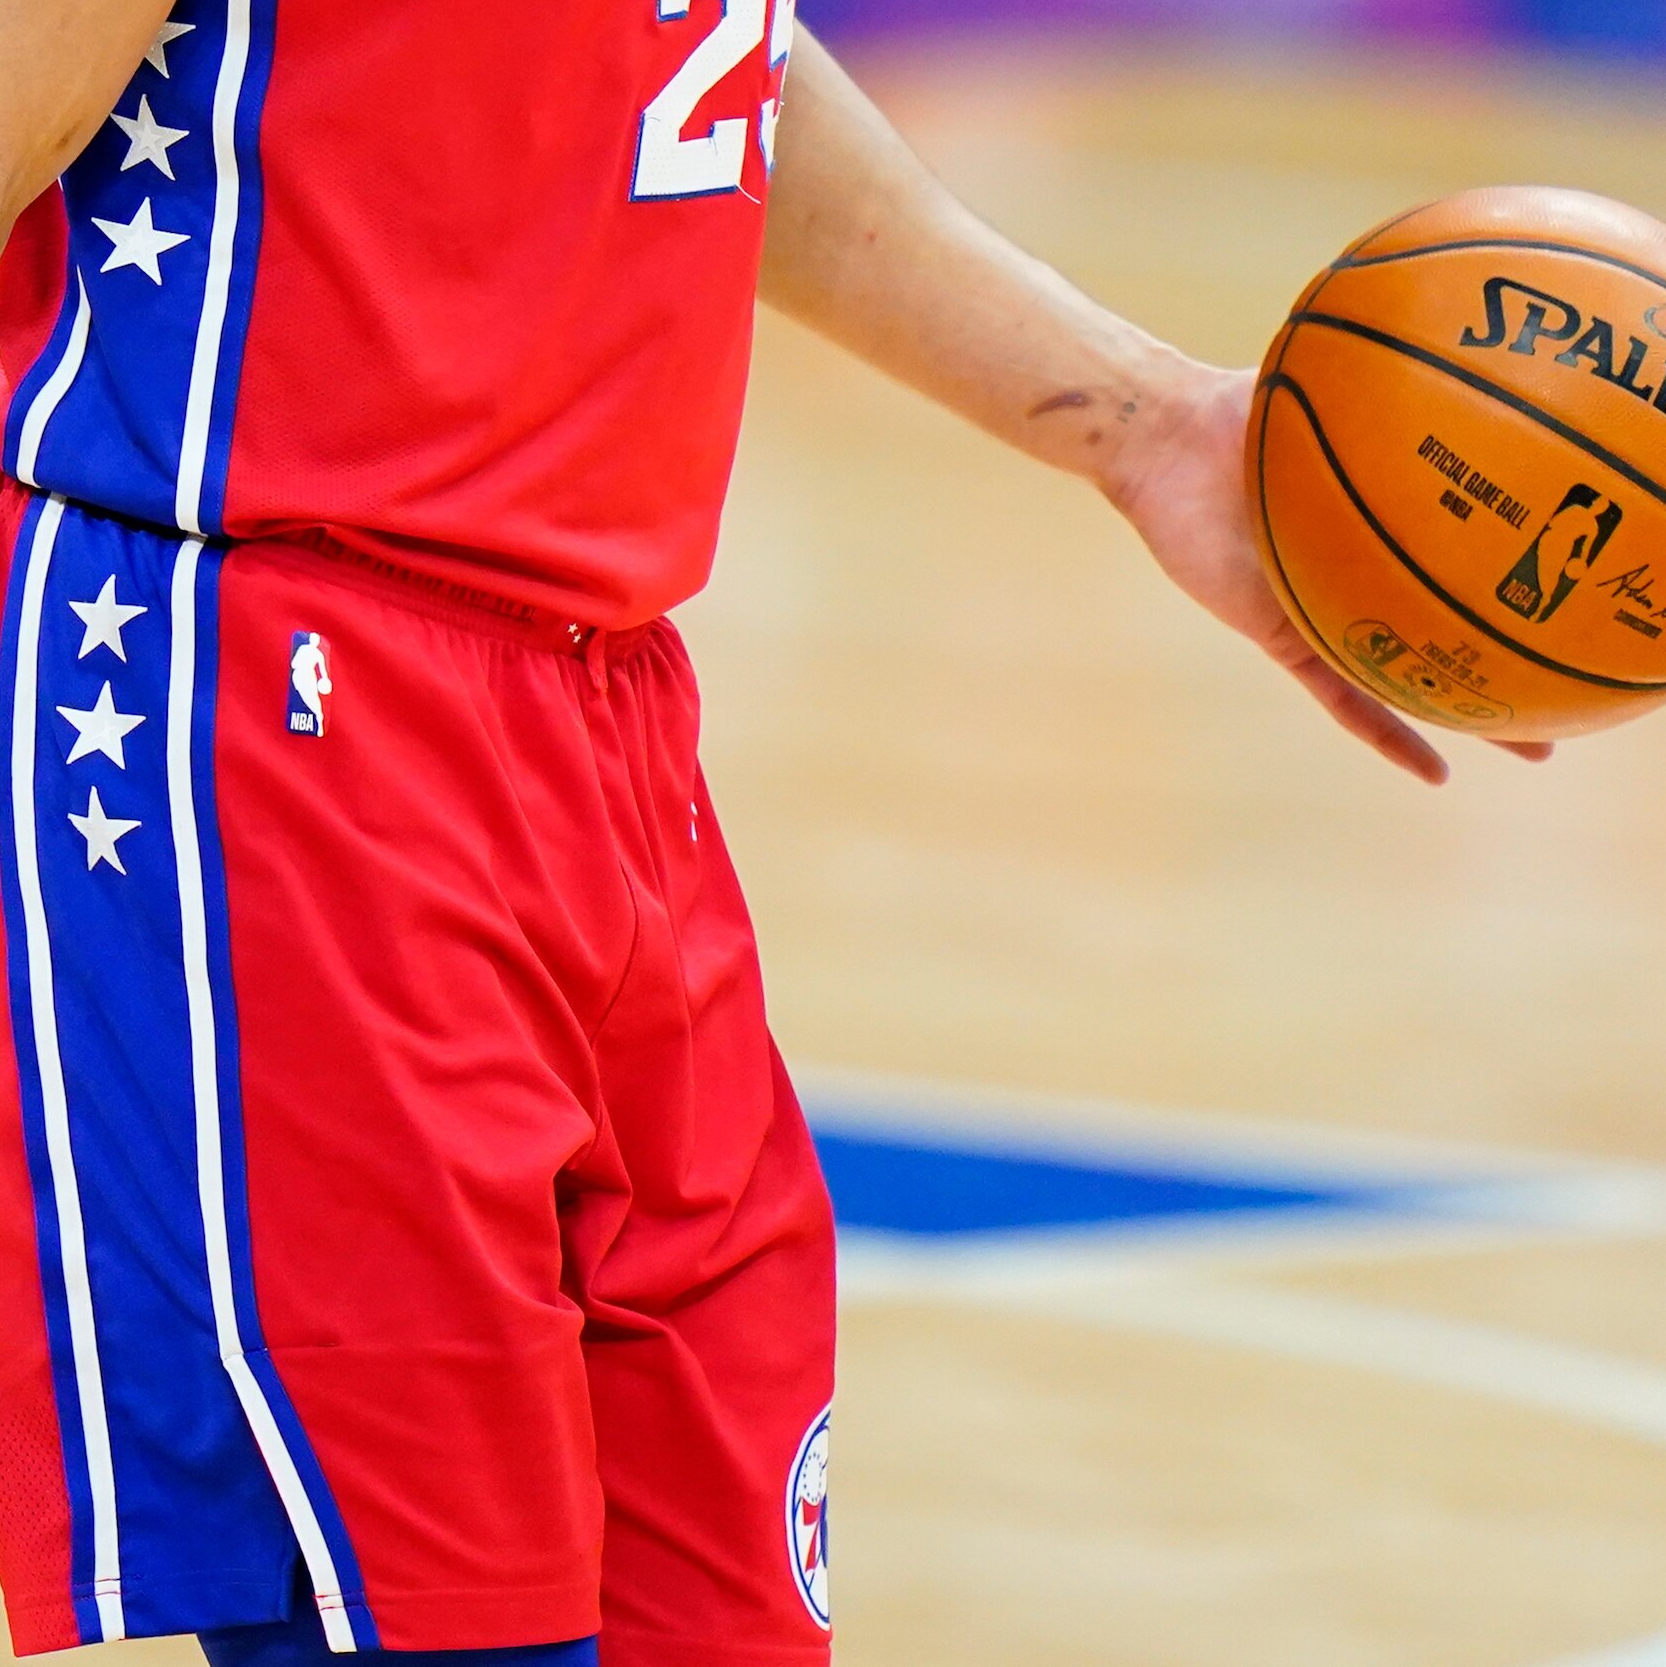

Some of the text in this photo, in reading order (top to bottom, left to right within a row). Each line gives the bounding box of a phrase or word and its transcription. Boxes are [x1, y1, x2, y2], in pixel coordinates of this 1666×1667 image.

[1417, 434, 1531, 531] OFFICIAL GAME BALL
[1501, 578, 1538, 611] NBA
[290, 711, 314, 732] NBA
